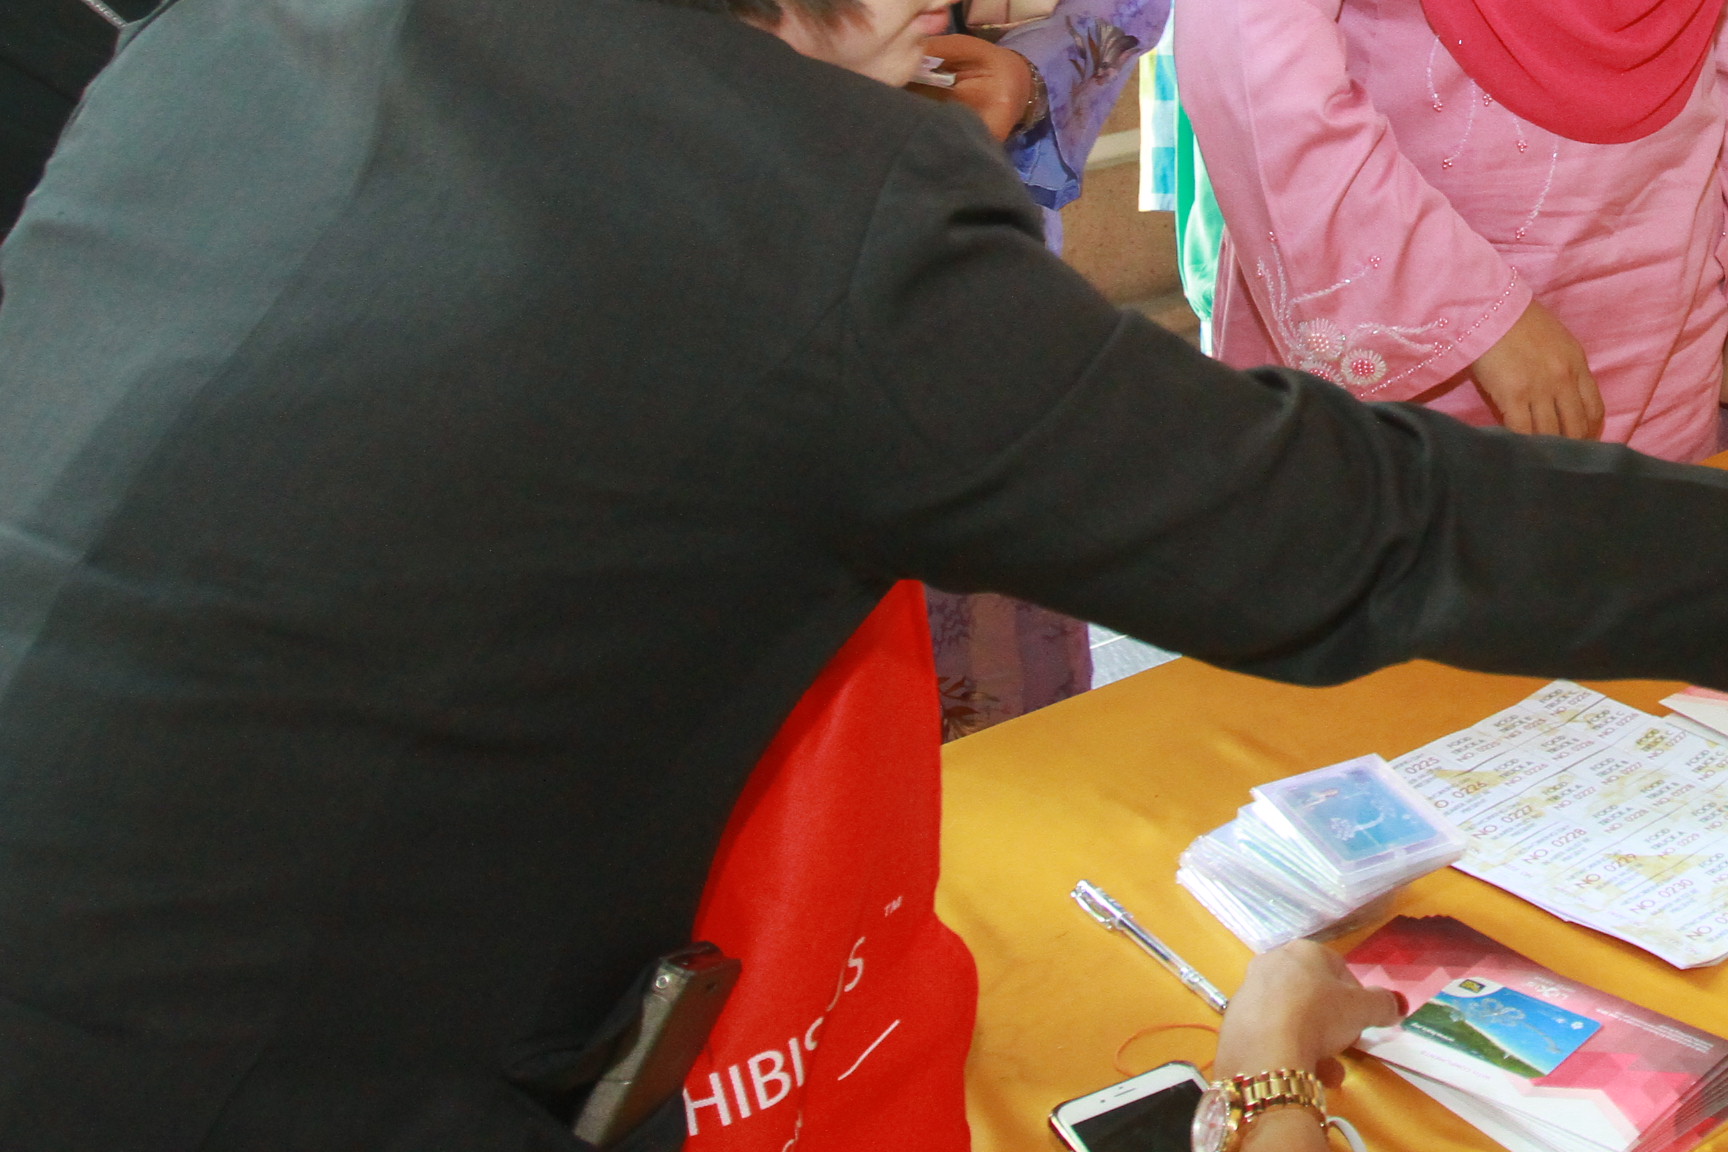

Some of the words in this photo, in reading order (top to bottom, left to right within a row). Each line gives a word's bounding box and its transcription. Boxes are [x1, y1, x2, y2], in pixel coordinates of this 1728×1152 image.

[1540, 689, 1563, 704] FOOD
[1494, 714, 1519, 727] FOOD
[1586, 710, 1610, 725] FOOD
[1447, 736, 1472, 748] FOOD
[1540, 736, 1565, 749] FOOD
[1636, 729, 1659, 744] FOOD
[1494, 758, 1519, 771] FOOD
[1590, 758, 1615, 771] FOOD
[1685, 750, 1709, 765] FOOD
[1405, 758, 1440, 774] 0225
[1542, 782, 1567, 795] FOOD
[1641, 780, 1665, 794] FOOD
[1501, 805, 1534, 823] 0227
[1592, 805, 1618, 818] FOOD
[1692, 803, 1716, 817] FOOD
[1552, 828, 1586, 848] 0228
[1644, 829, 1670, 843] FOOD
[1604, 853, 1636, 872] 0229
[1699, 853, 1725, 867] FOOD
[1659, 879, 1693, 898] 0230
